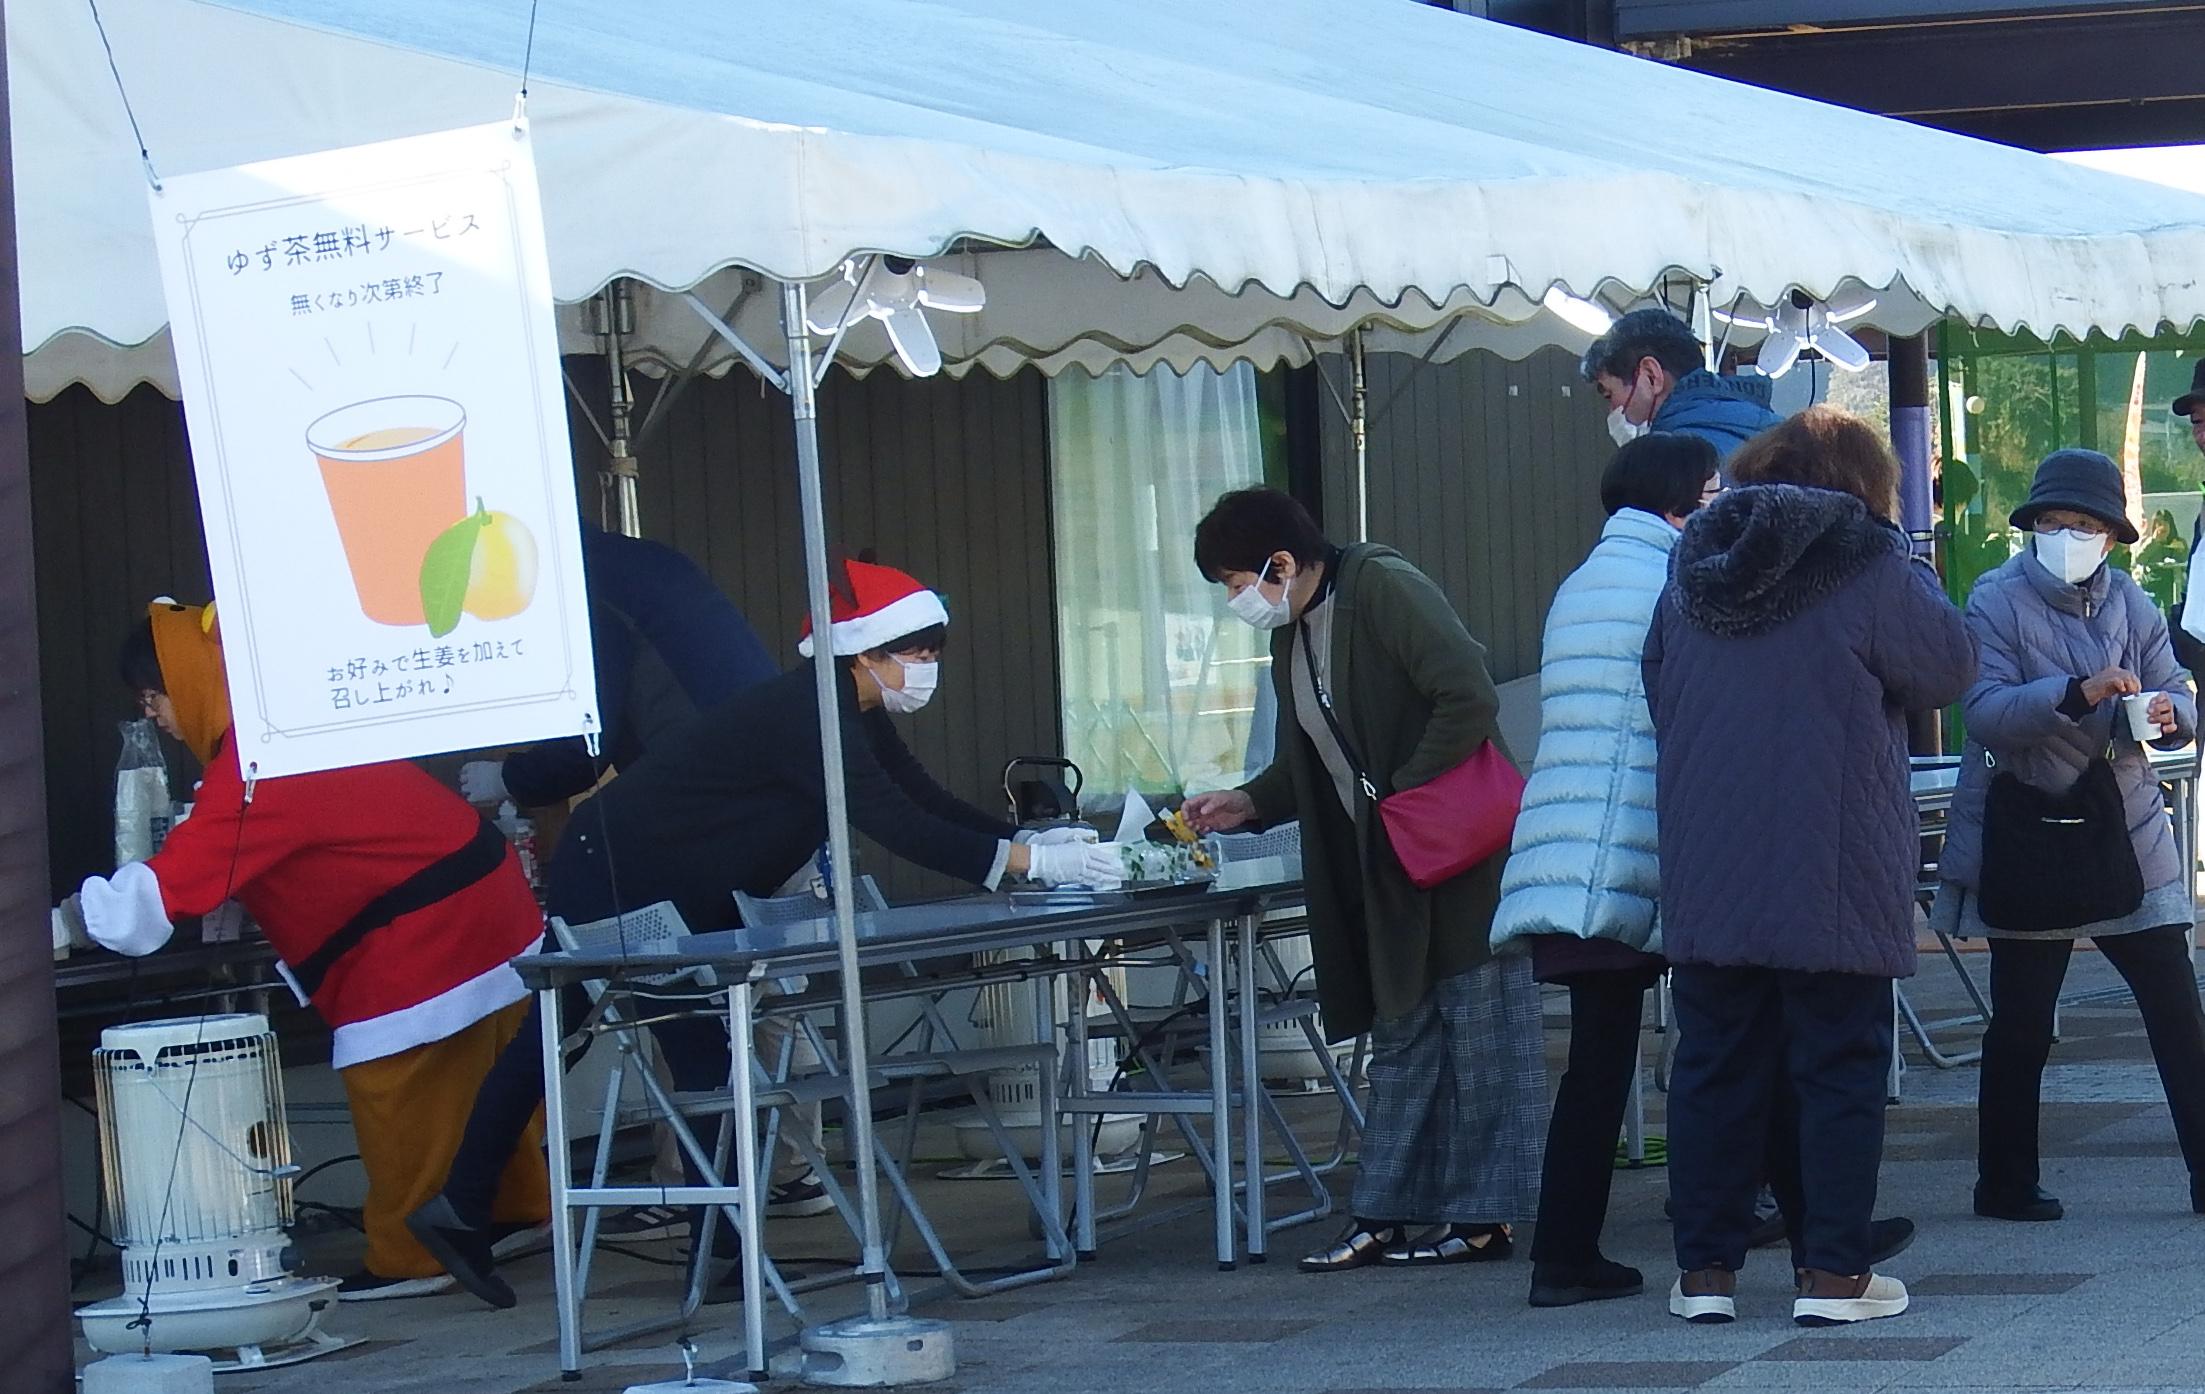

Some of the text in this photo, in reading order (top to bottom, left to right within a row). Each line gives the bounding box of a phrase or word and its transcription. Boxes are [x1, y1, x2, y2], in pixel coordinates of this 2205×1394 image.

[227, 214, 480, 276] ゆず茶無料サービス
[290, 271, 443, 316] 無くなり次第終了
[327, 638, 524, 682] お好みで生姜を加えて
